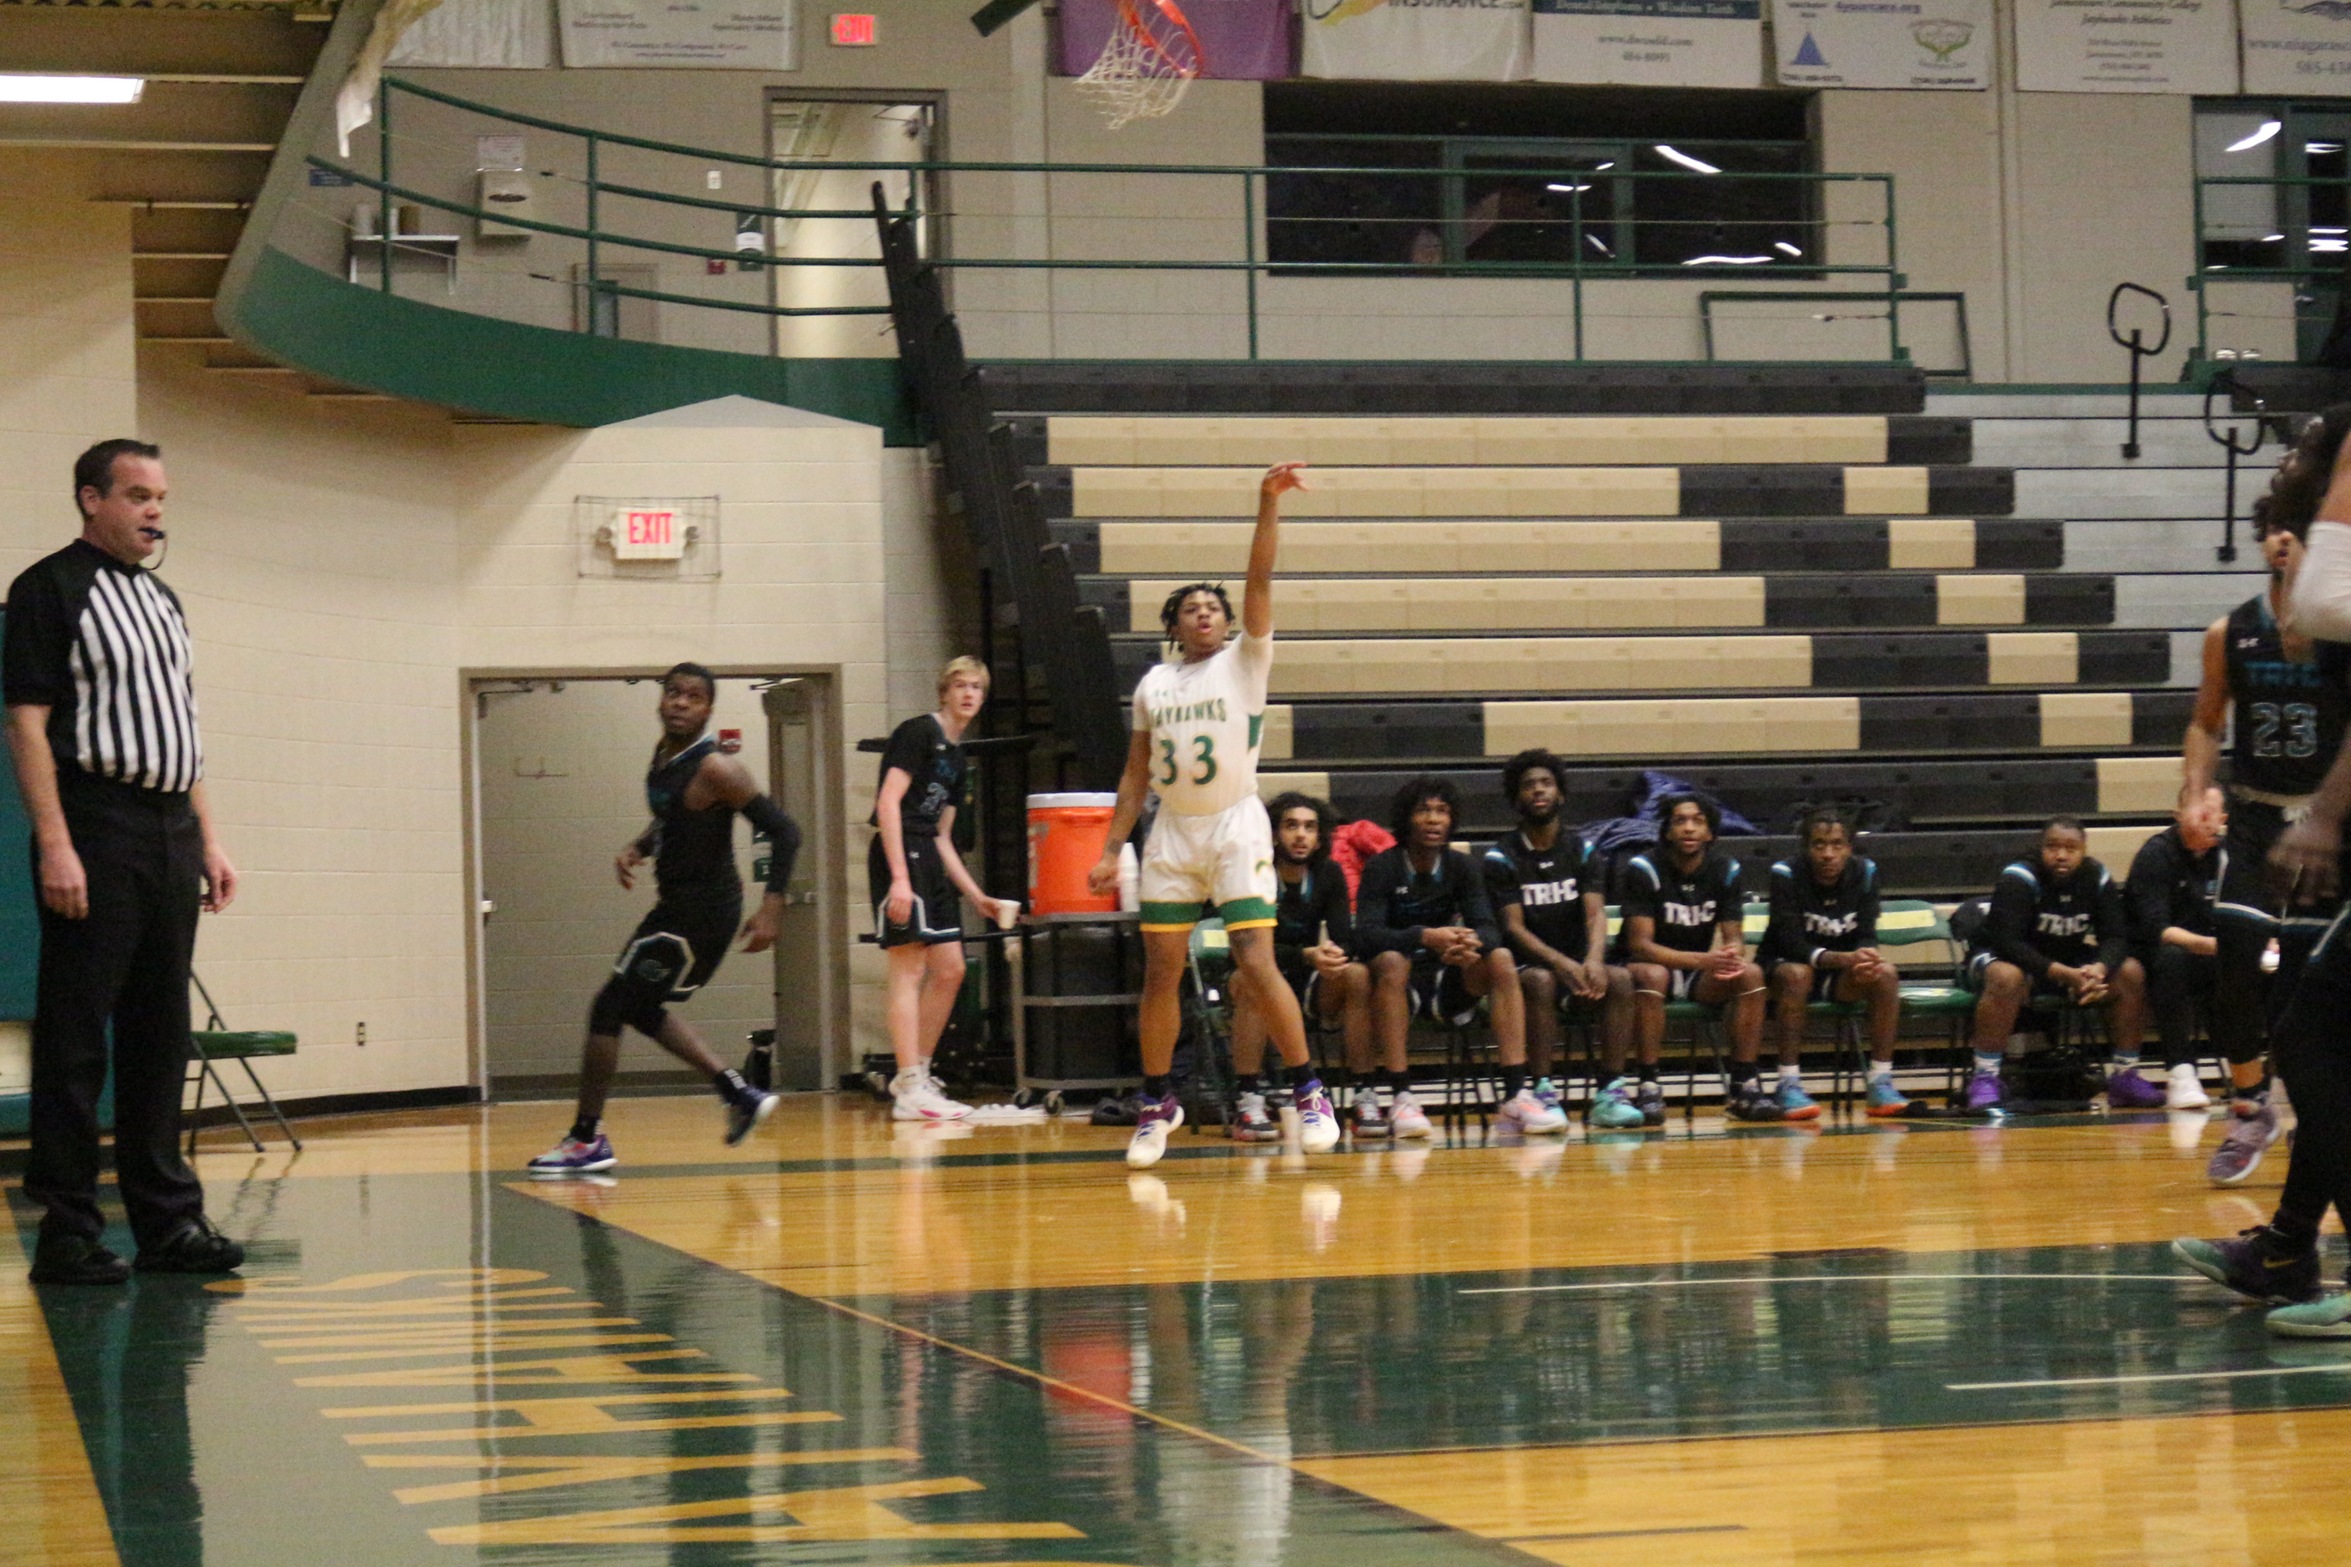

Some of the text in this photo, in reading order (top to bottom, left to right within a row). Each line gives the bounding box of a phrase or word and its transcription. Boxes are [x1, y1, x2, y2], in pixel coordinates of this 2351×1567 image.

[838, 14, 875, 42] EXIT
[628, 512, 673, 544] EXIT
[2250, 701, 2318, 758] 23
[1160, 735, 1217, 785] 33
[204, 1267, 1139, 1567] AYHAWKS
